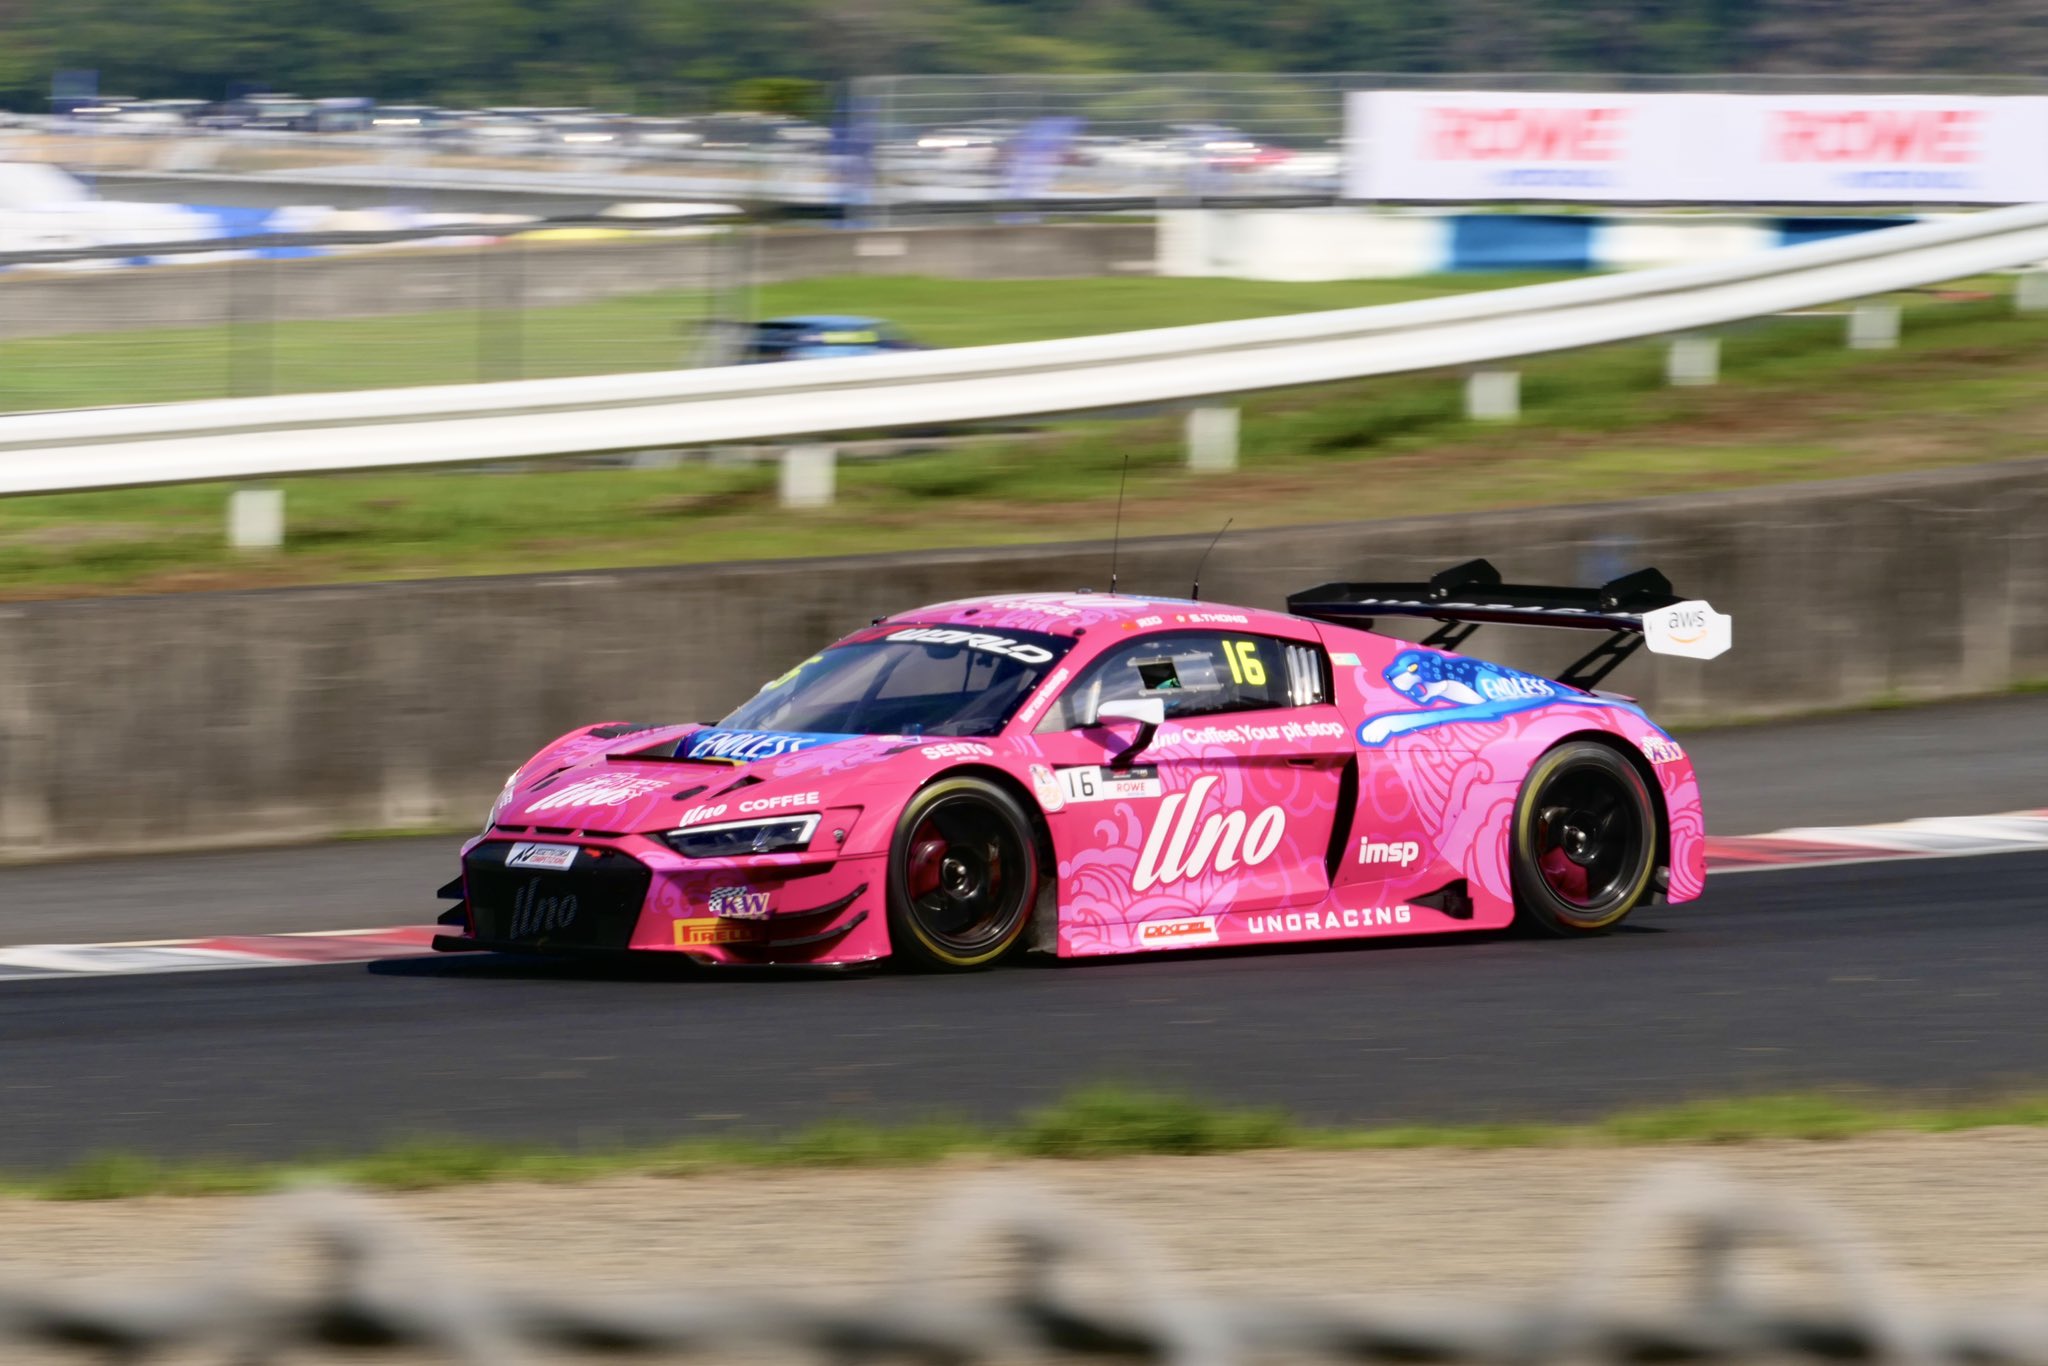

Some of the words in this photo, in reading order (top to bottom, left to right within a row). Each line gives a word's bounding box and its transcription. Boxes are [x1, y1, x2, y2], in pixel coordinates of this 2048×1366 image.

[1667, 610, 1706, 630] aws
[885, 628, 1054, 664] WORLD
[1222, 640, 1267, 686] 16
[1482, 676, 1556, 700] ENDLESS
[1281, 722, 1306, 743] pit
[1306, 721, 1345, 739] stop
[1068, 771, 1094, 798] 16
[1116, 782, 1145, 792] ROWE
[738, 791, 820, 813] COFFEE
[1358, 836, 1419, 867] imsp
[718, 892, 770, 917] KW
[1248, 905, 1411, 934] UNORACING
